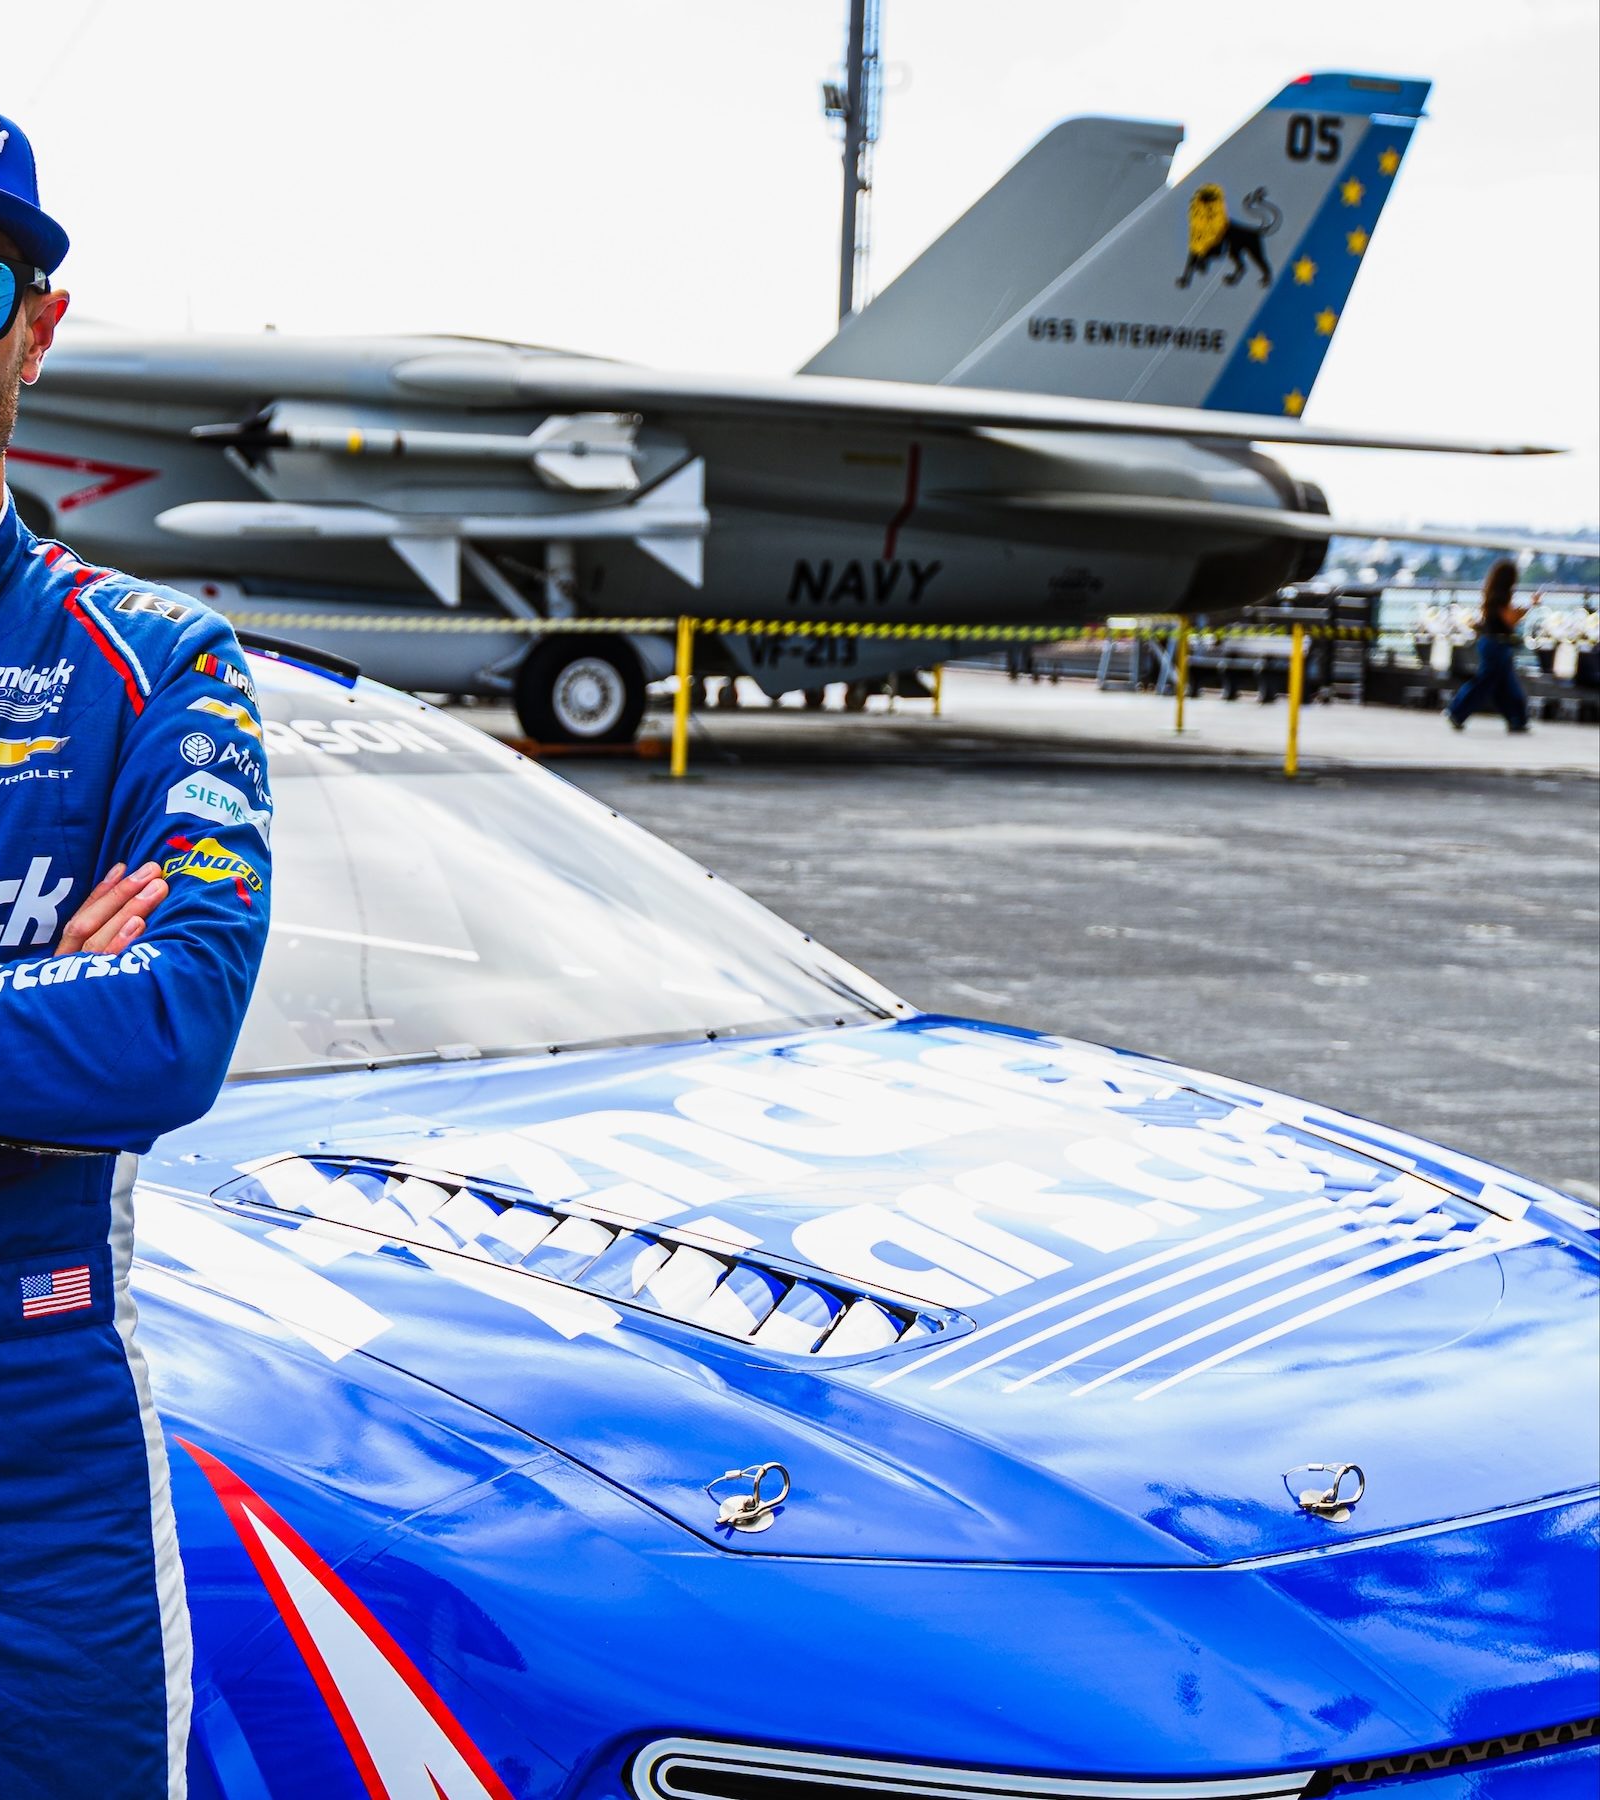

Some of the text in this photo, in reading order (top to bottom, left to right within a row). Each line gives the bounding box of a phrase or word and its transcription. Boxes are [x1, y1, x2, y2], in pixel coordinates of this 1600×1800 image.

[1285, 112, 1343, 164] 05
[1028, 316, 1227, 354] USS ENTERPRISE
[787, 558, 944, 604] NAVY
[223, 663, 258, 702] NAS
[263, 719, 449, 753] RSON
[185, 784, 250, 824] SIEME
